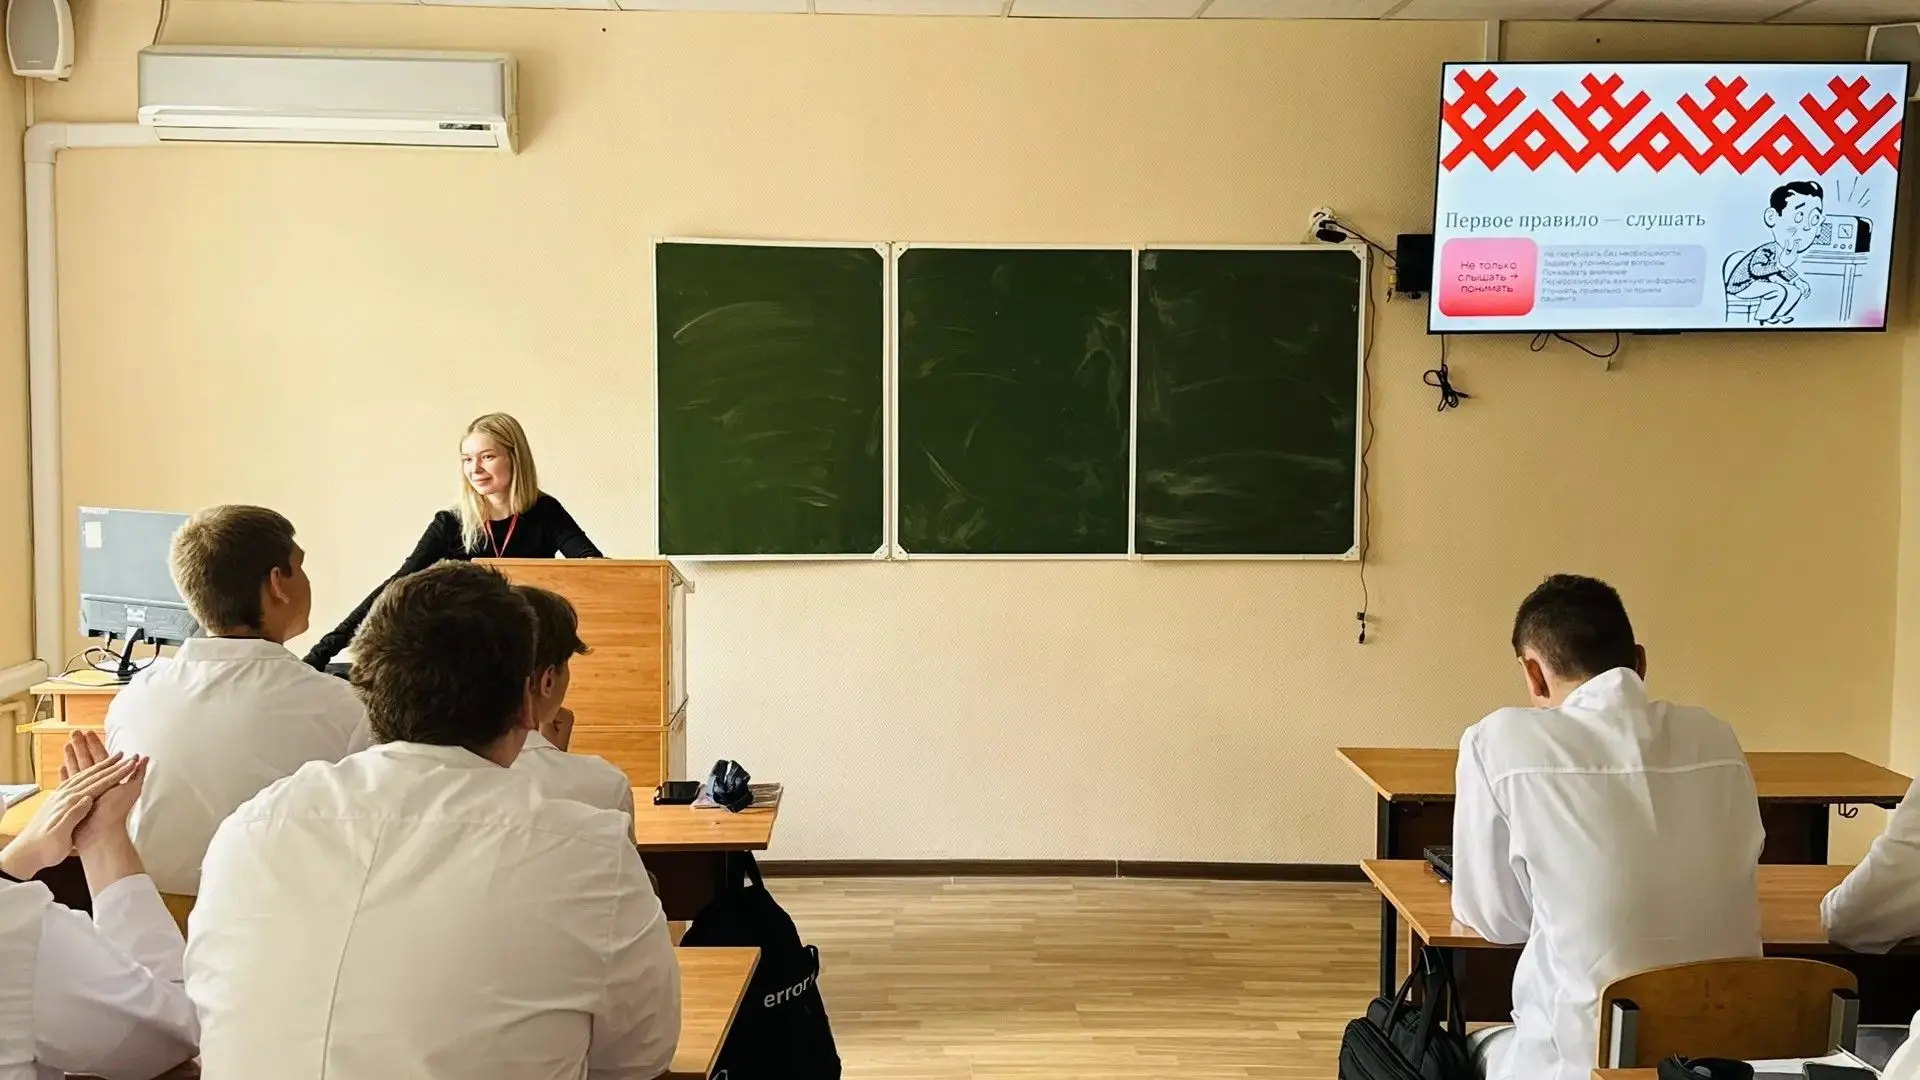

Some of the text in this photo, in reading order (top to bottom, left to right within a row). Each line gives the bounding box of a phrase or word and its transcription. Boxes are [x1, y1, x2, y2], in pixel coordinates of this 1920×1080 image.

[1446, 211, 1514, 232] Первое
[1519, 214, 1599, 232] правило
[1625, 213, 1706, 231] слушать
[1460, 260, 1518, 270] Не только
[1457, 274, 1507, 282] слышать
[1461, 285, 1514, 293] понимать
